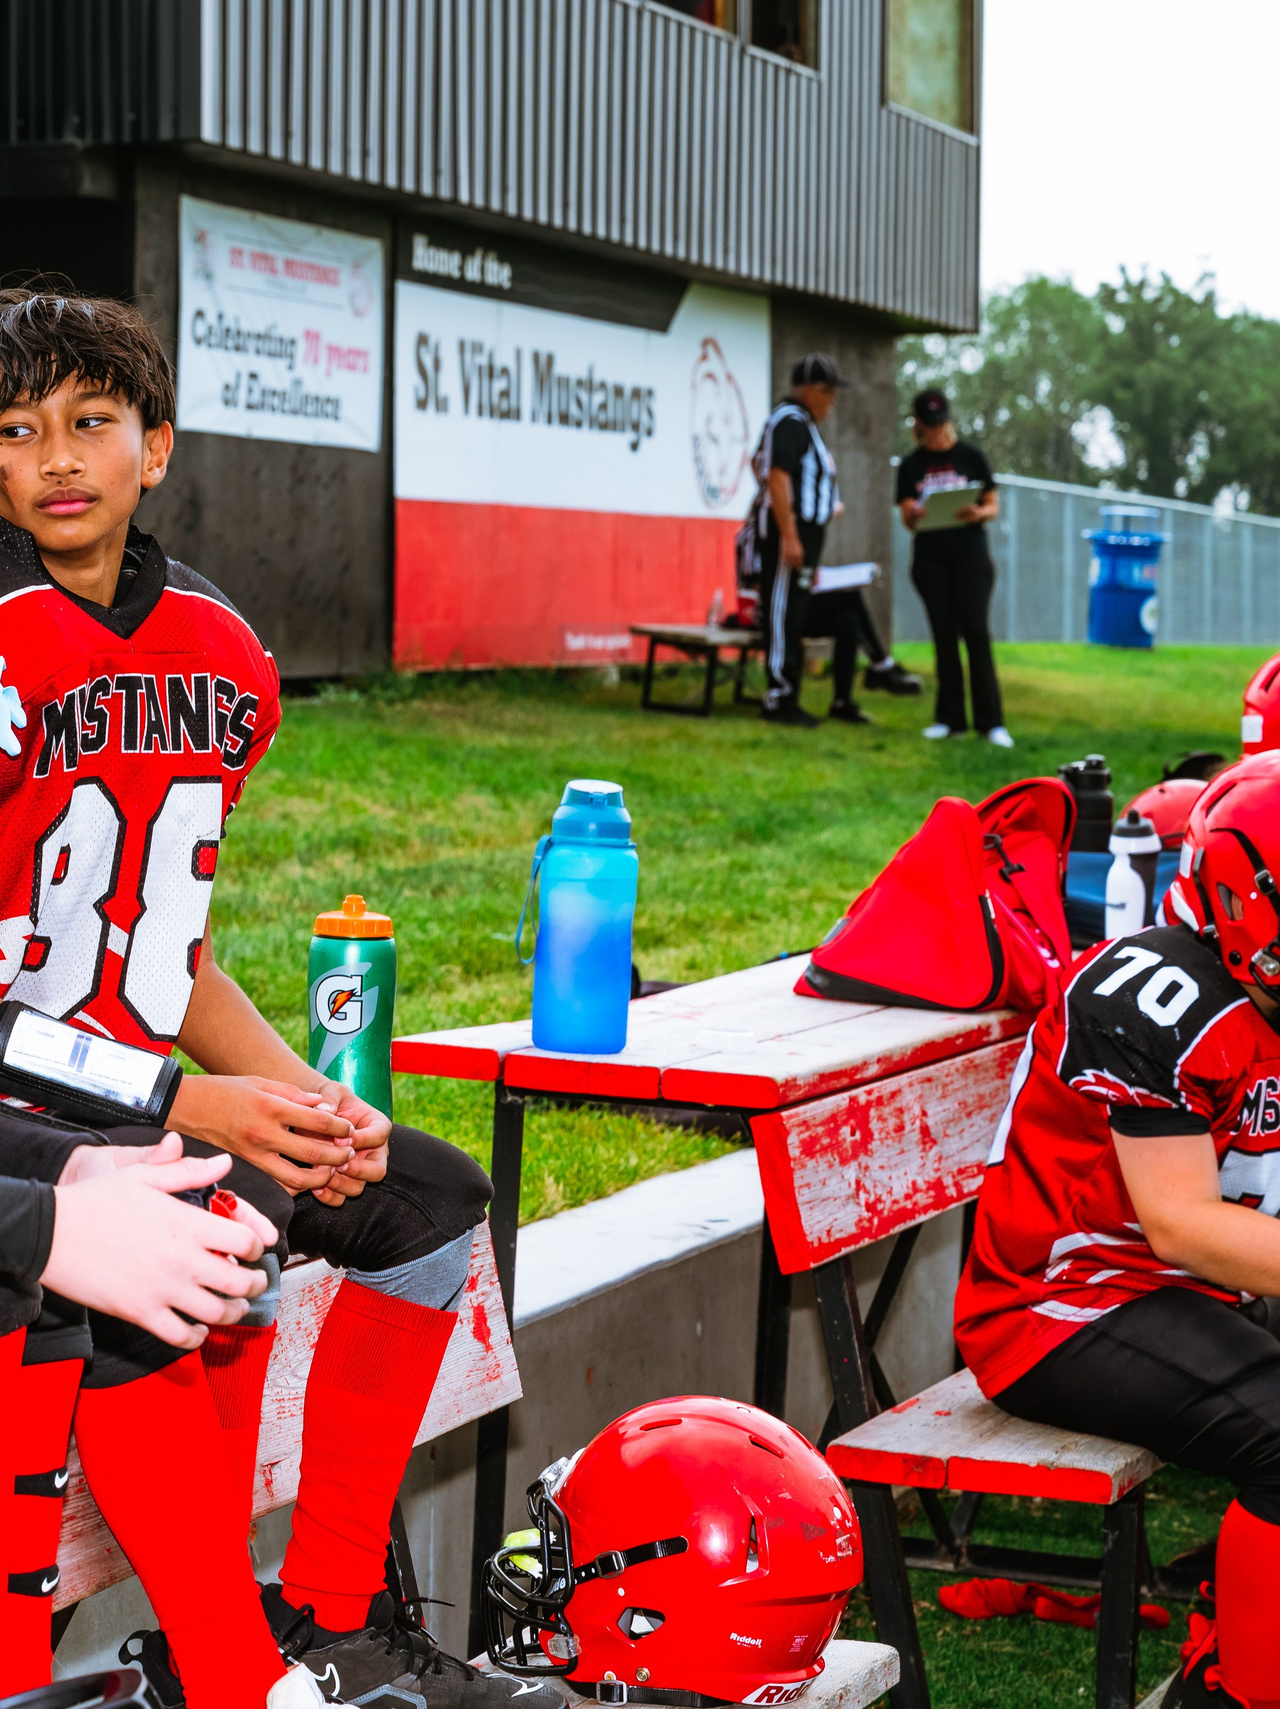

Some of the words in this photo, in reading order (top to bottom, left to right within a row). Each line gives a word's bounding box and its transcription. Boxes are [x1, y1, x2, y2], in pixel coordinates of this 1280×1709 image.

[412, 232, 461, 280] Home
[464, 246, 483, 283] of
[484, 251, 513, 290] the
[191, 307, 297, 371] Celebrating
[325, 343, 370, 378] years
[222, 370, 241, 409] of
[245, 371, 341, 421] Excellence
[415, 331, 448, 414] St.
[459, 338, 521, 422] Vital
[532, 350, 656, 453] Mustangs
[315, 974, 364, 1036] G
[1093, 946, 1200, 1027] 70
[729, 1632, 763, 1648] Riddell
